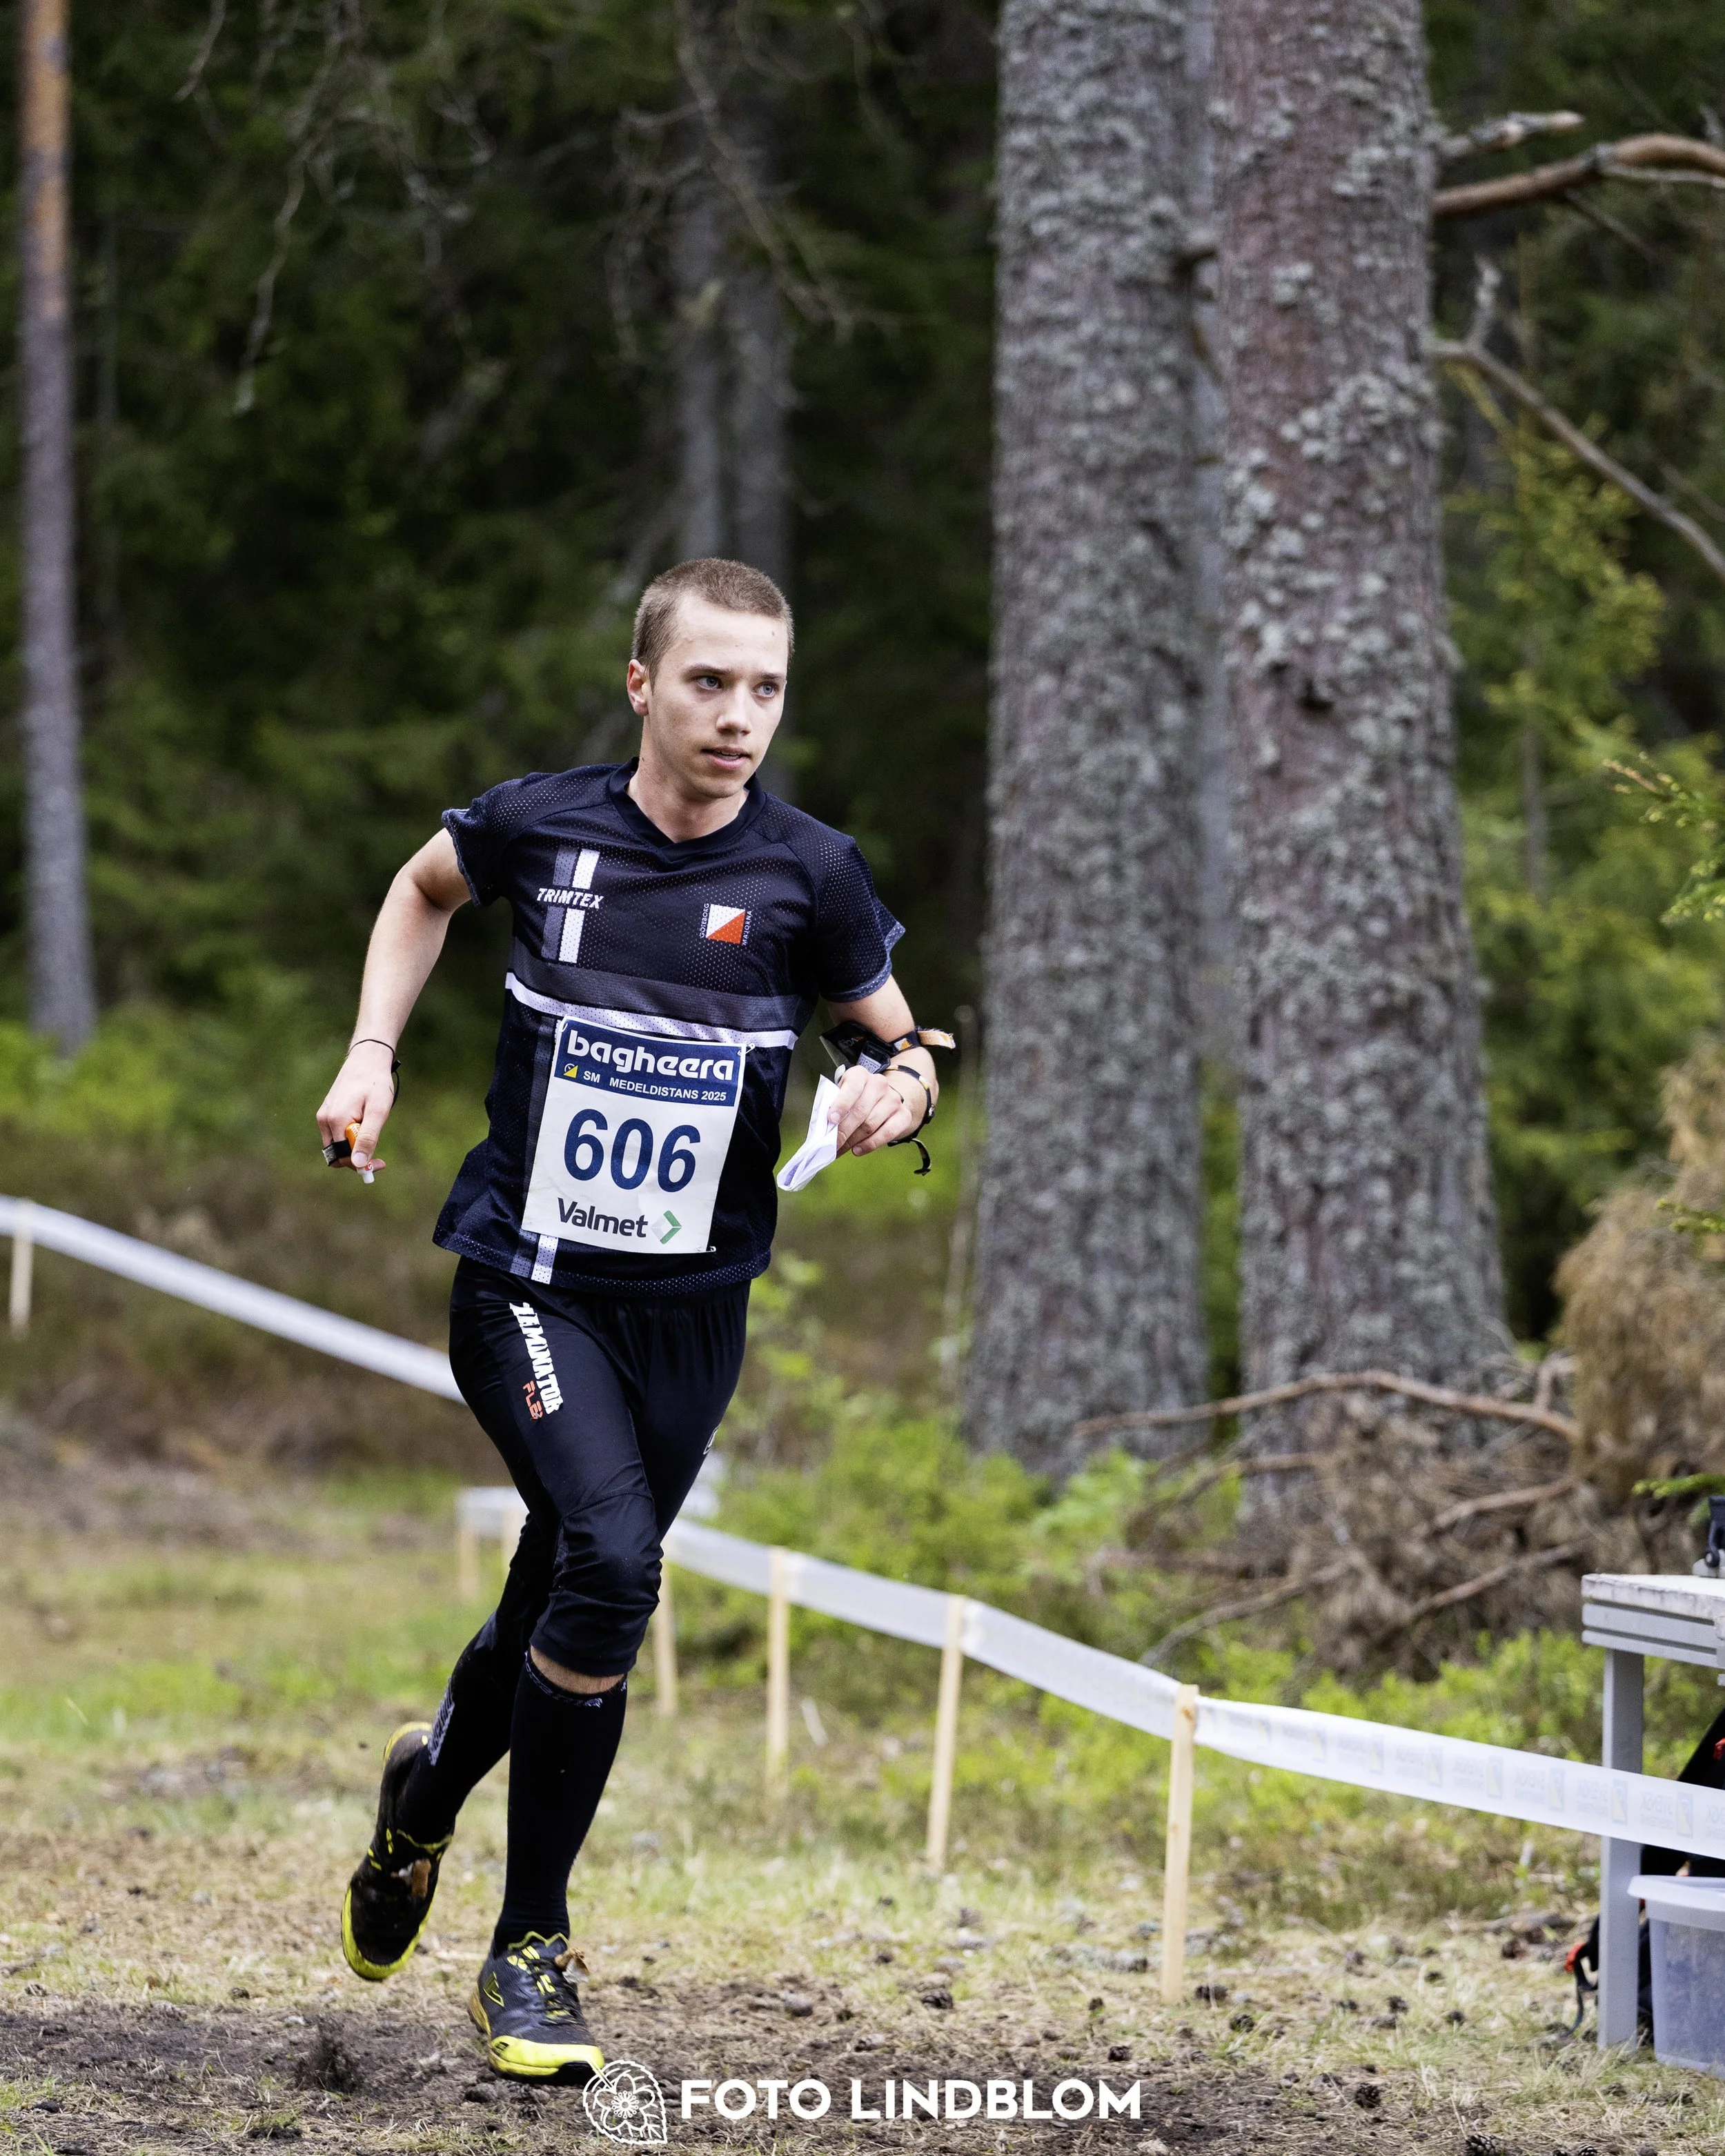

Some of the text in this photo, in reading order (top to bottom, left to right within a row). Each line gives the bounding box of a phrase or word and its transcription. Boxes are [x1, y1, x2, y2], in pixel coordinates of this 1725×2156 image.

[536, 887, 604, 909] TRIMTEX
[699, 902, 709, 939] GÖTEBORG
[742, 910, 753, 946] MAJORNA
[566, 1029, 734, 1081] bagheera
[583, 1070, 727, 1102] SM MEDELDISTANS 2025
[564, 1108, 701, 1193] 606
[558, 1197, 648, 1238] Valmet
